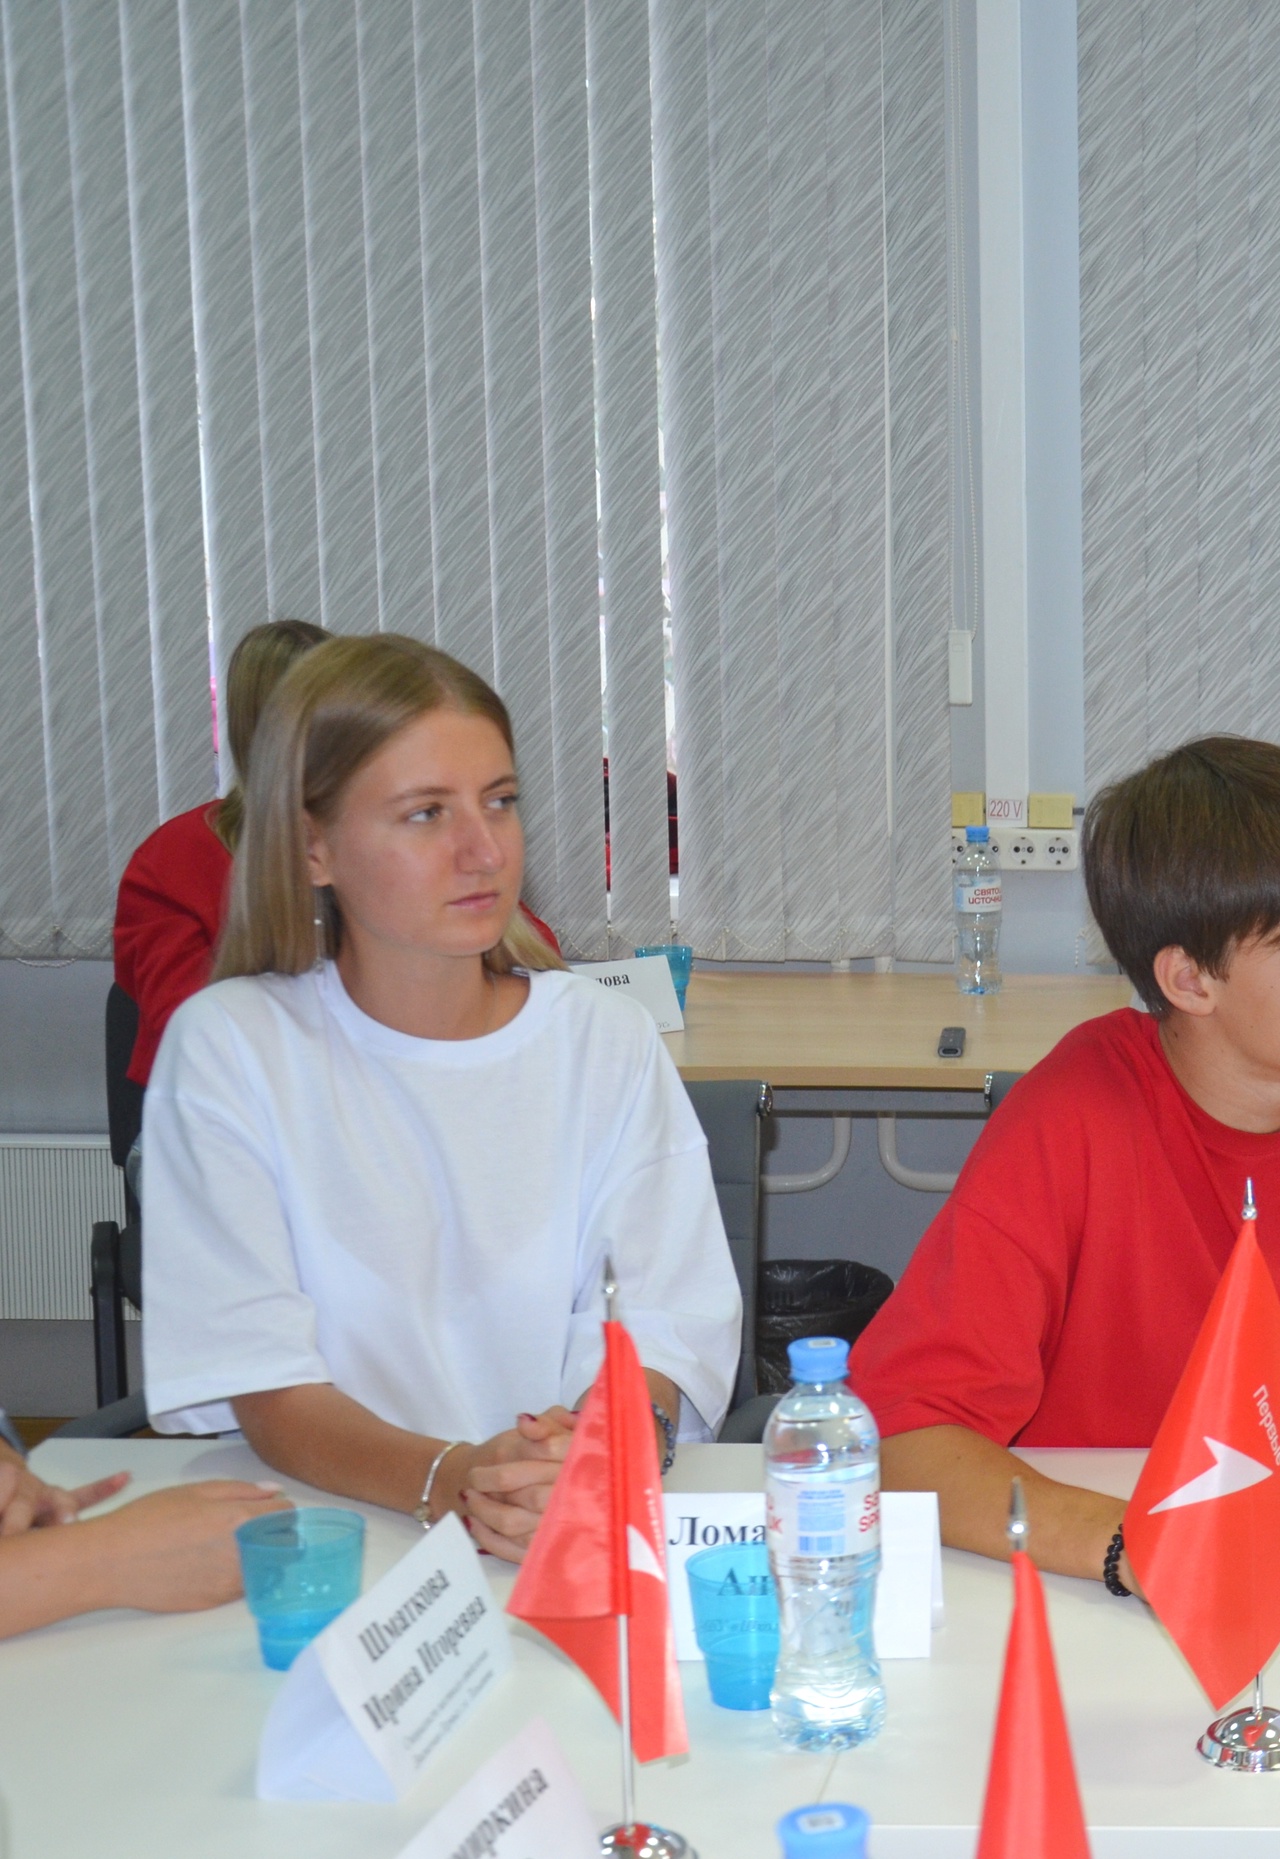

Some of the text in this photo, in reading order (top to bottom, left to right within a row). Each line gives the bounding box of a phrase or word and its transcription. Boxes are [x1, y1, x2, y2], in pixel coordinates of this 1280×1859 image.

[990, 800, 1022, 818] 220 V
[974, 888, 1001, 896] СВЯТО
[668, 1516, 767, 1546] Лома
[358, 1569, 450, 1663] Шматкова
